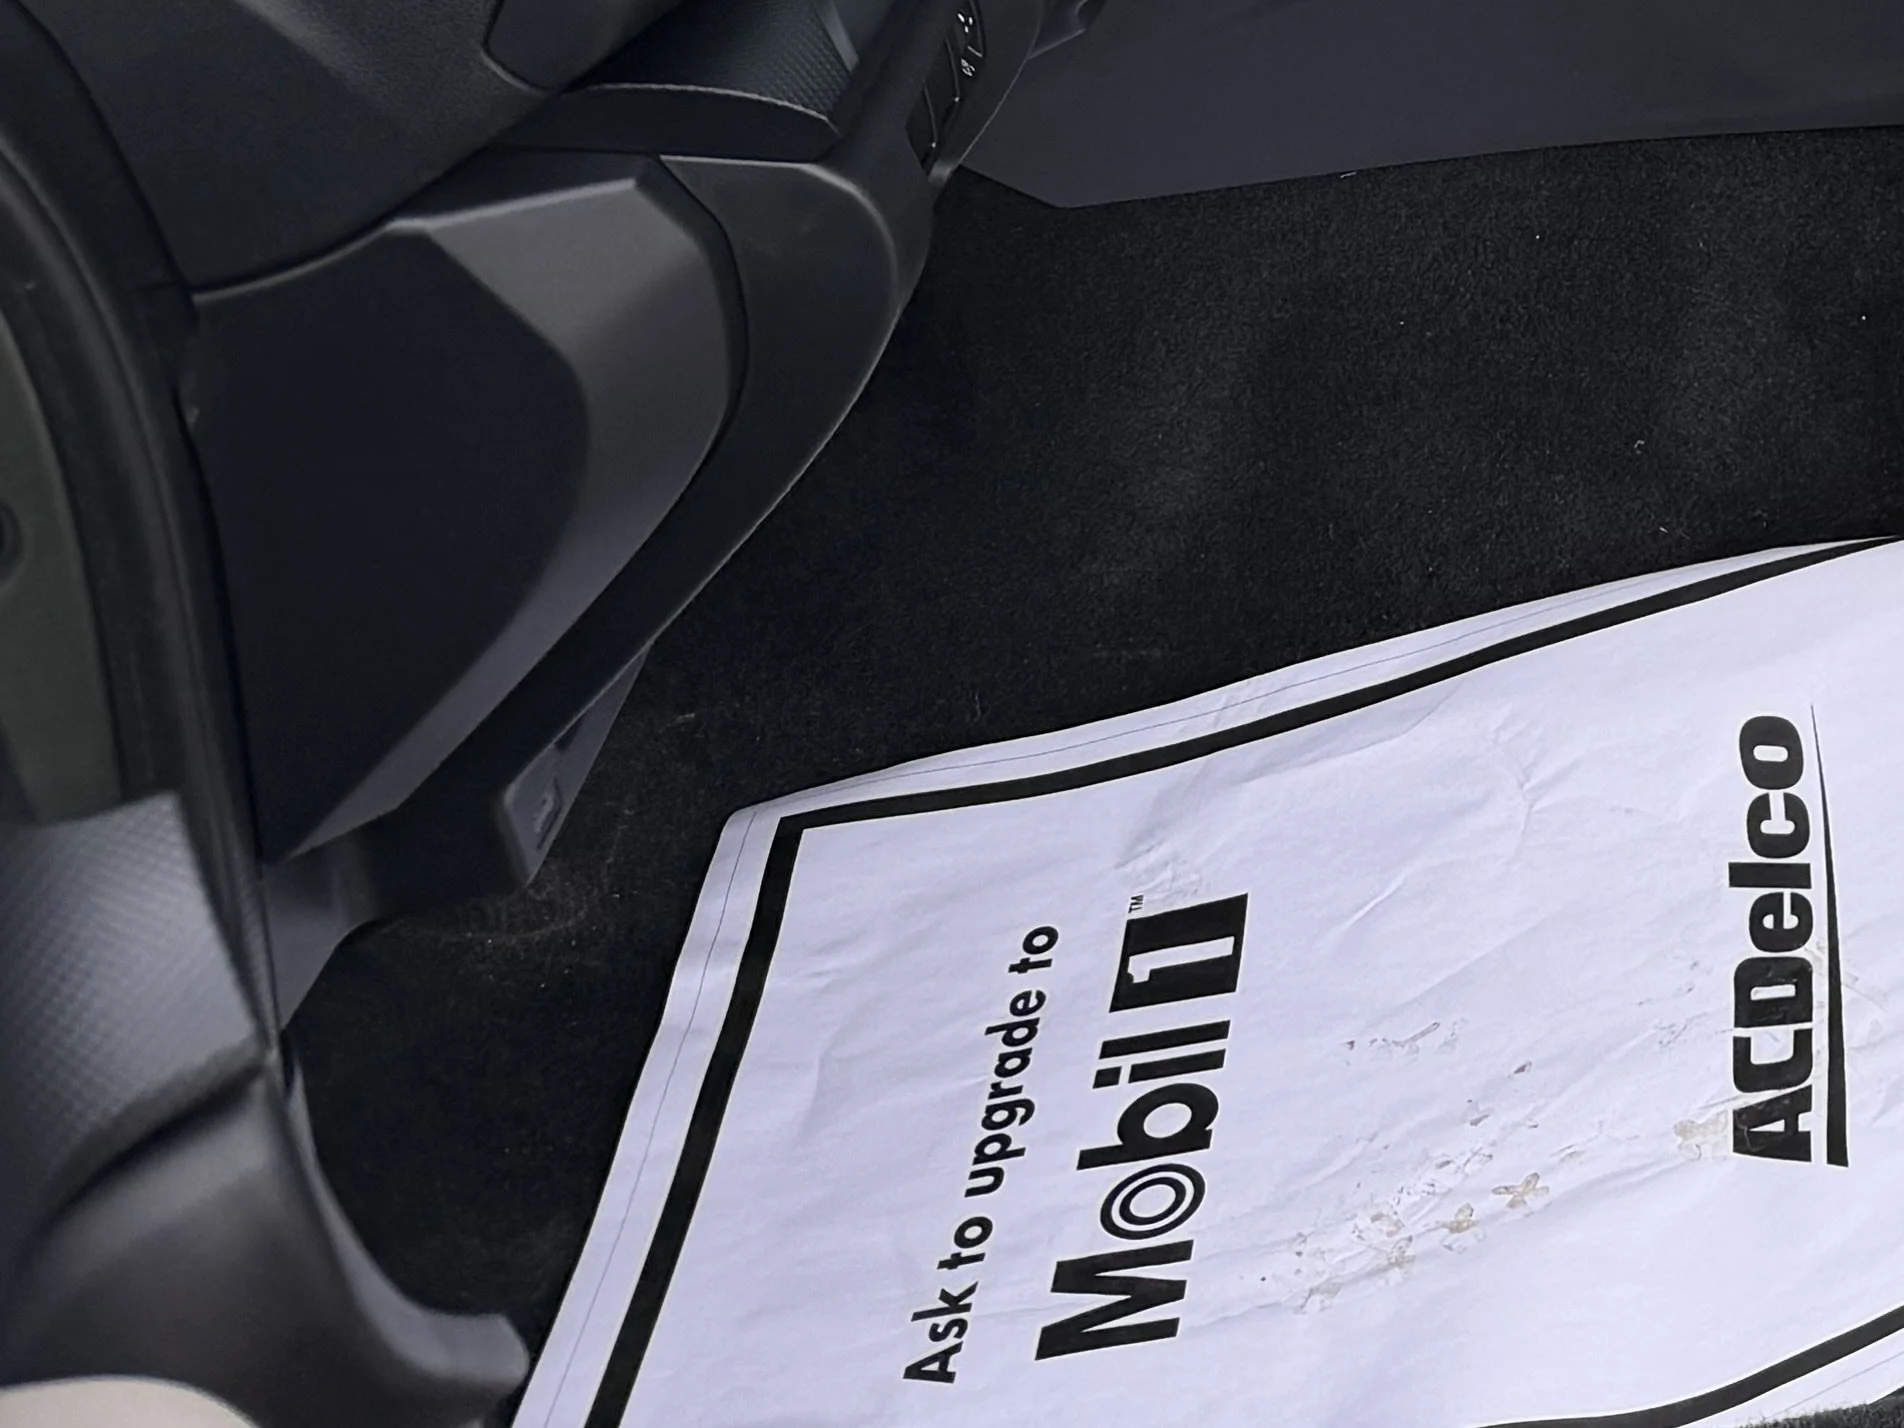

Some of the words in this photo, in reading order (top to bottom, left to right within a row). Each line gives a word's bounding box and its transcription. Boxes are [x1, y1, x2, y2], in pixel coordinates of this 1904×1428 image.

[1008, 925, 1059, 974] to
[1729, 715, 1814, 1162] ACDelco
[965, 989, 1046, 1197] upgrade
[937, 1215, 993, 1270] to
[1035, 1019, 1231, 1360] Mobil
[903, 1281, 979, 1383] Ask
